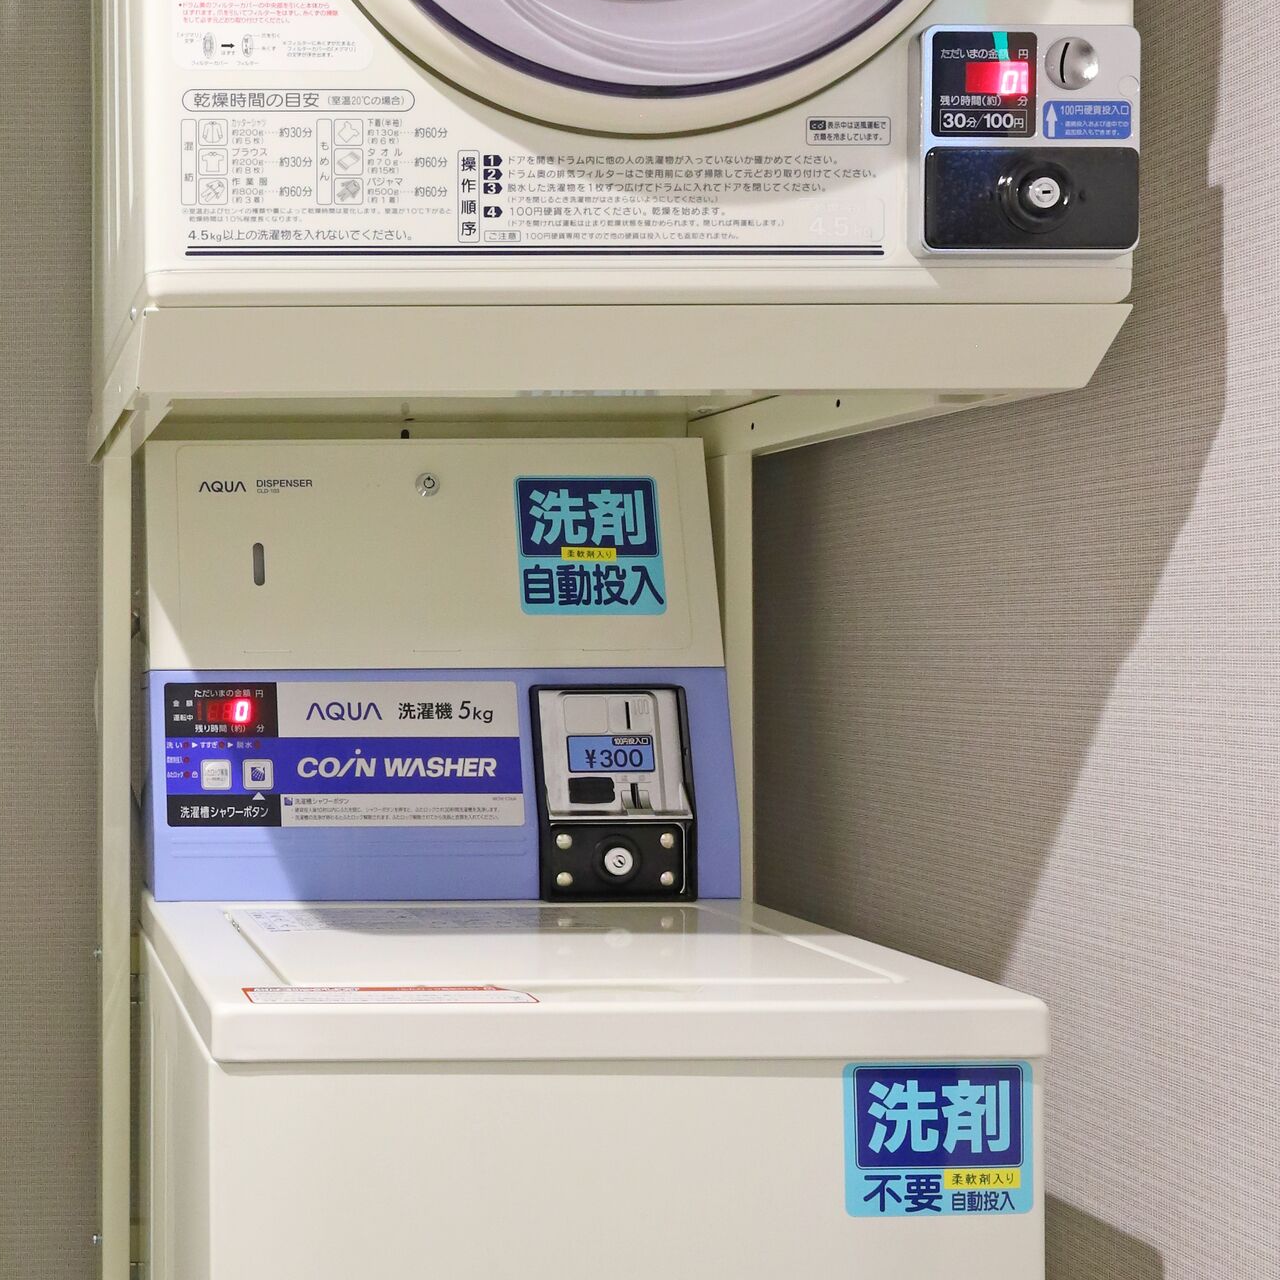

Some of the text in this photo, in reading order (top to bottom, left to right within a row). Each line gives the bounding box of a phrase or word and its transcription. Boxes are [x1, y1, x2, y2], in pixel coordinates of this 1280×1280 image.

[1019, 49, 1028, 59] 円
[194, 93, 320, 107] 乾燥時間の目安
[940, 96, 1028, 106] 残り時間(約) 分
[943, 114, 1024, 128] 30分/100円
[279, 128, 312, 138] 約30分
[414, 128, 448, 138] 約60分
[279, 157, 312, 167] 約30分
[414, 157, 448, 167] 約60分
[487, 157, 495, 165] 1
[486, 170, 496, 179] 2
[279, 187, 312, 197] 約60分
[414, 187, 448, 197] 約60分
[487, 184, 496, 192] 3
[461, 157, 476, 236] 操作順序
[486, 207, 496, 216] 4
[199, 481, 246, 492] AQUA
[529, 488, 648, 546] 洗剤
[566, 549, 614, 559] 柔軟剤入り
[523, 565, 665, 606] 自動投入
[256, 690, 263, 698] 円
[235, 701, 248, 721] 0
[306, 701, 494, 723] AQUA 洗濯機 5kg
[195, 725, 246, 733] 残り時間(約)
[585, 749, 643, 768] ¥300
[384, 758, 497, 777] WASHER
[180, 806, 268, 818] 洗濯槽シャワーボタン
[868, 1080, 1010, 1153] 洗剤
[952, 1173, 1014, 1185] 柔軟剤入り
[863, 1174, 942, 1212] 不要
[952, 1191, 1015, 1211] 自動投入
